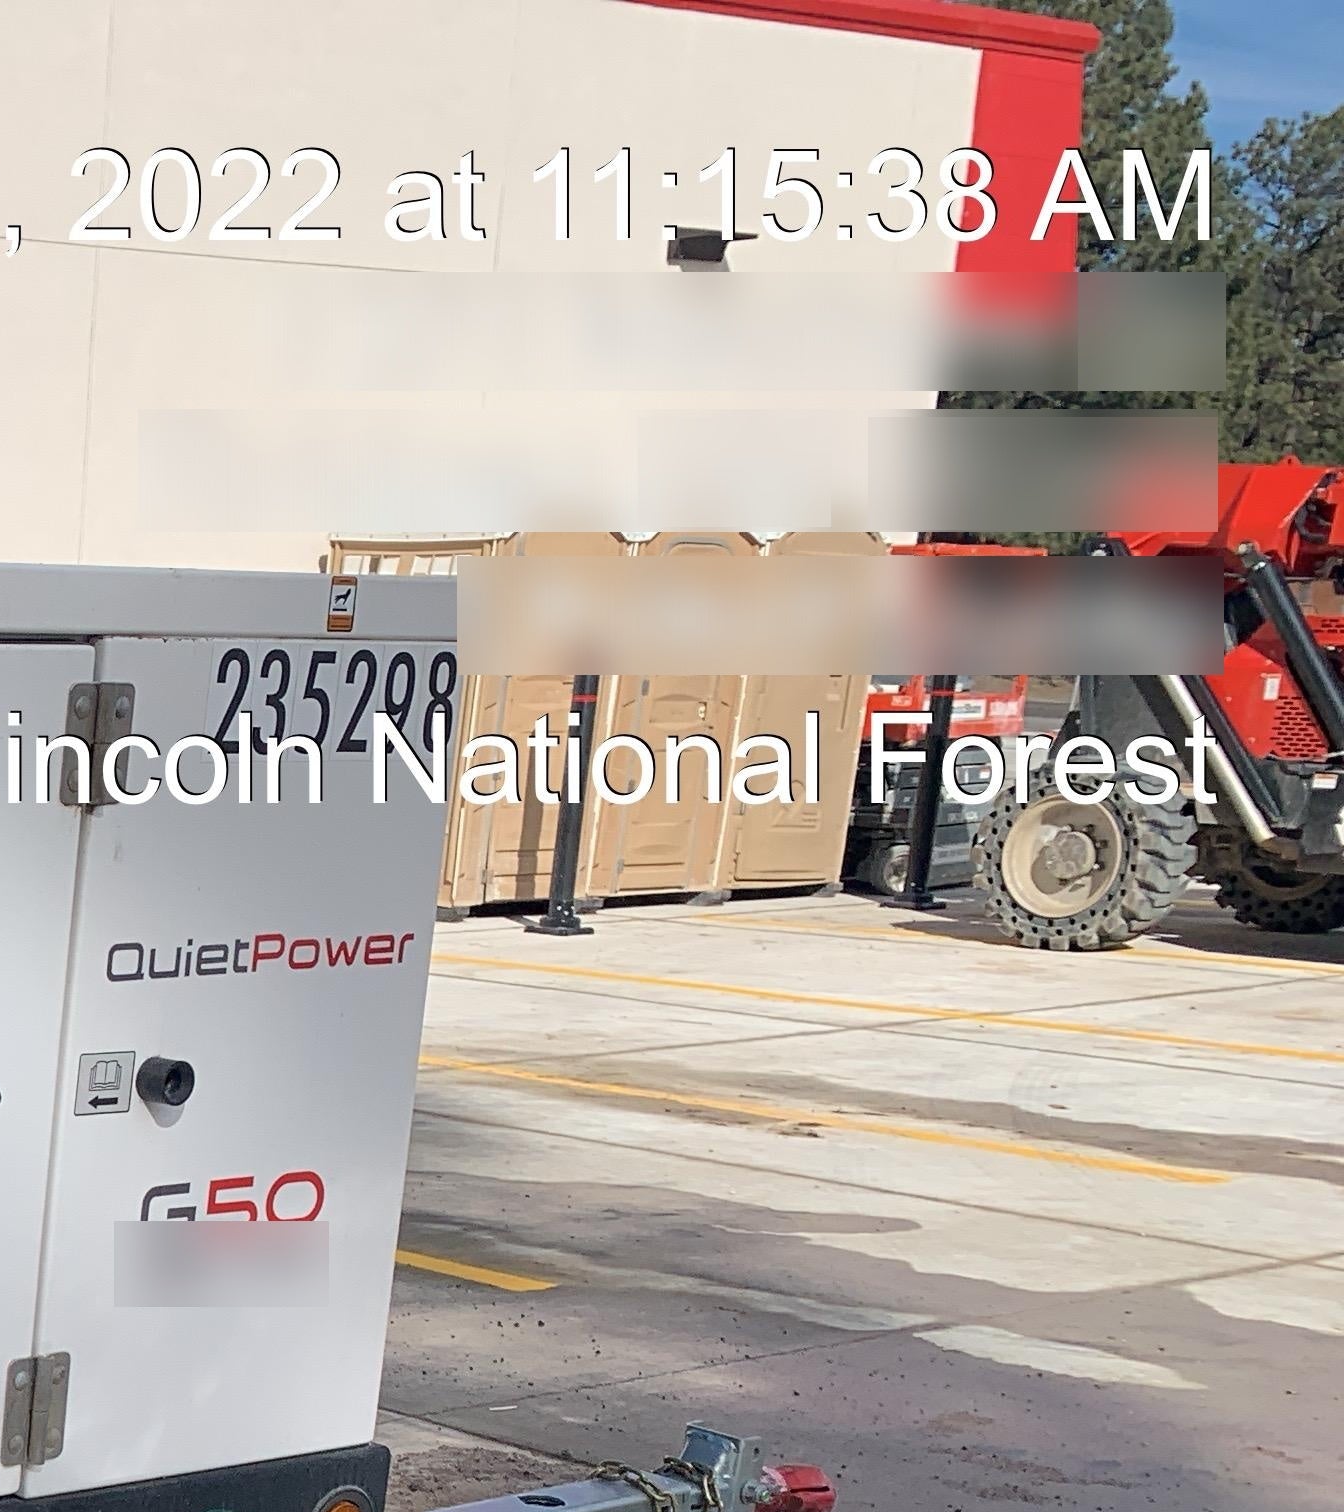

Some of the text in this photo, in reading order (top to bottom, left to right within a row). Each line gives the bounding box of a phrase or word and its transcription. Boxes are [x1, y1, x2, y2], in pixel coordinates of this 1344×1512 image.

[208, 648, 457, 755] 235298
[105, 932, 416, 983] QuietPower
[139, 1169, 326, 1222] G50
